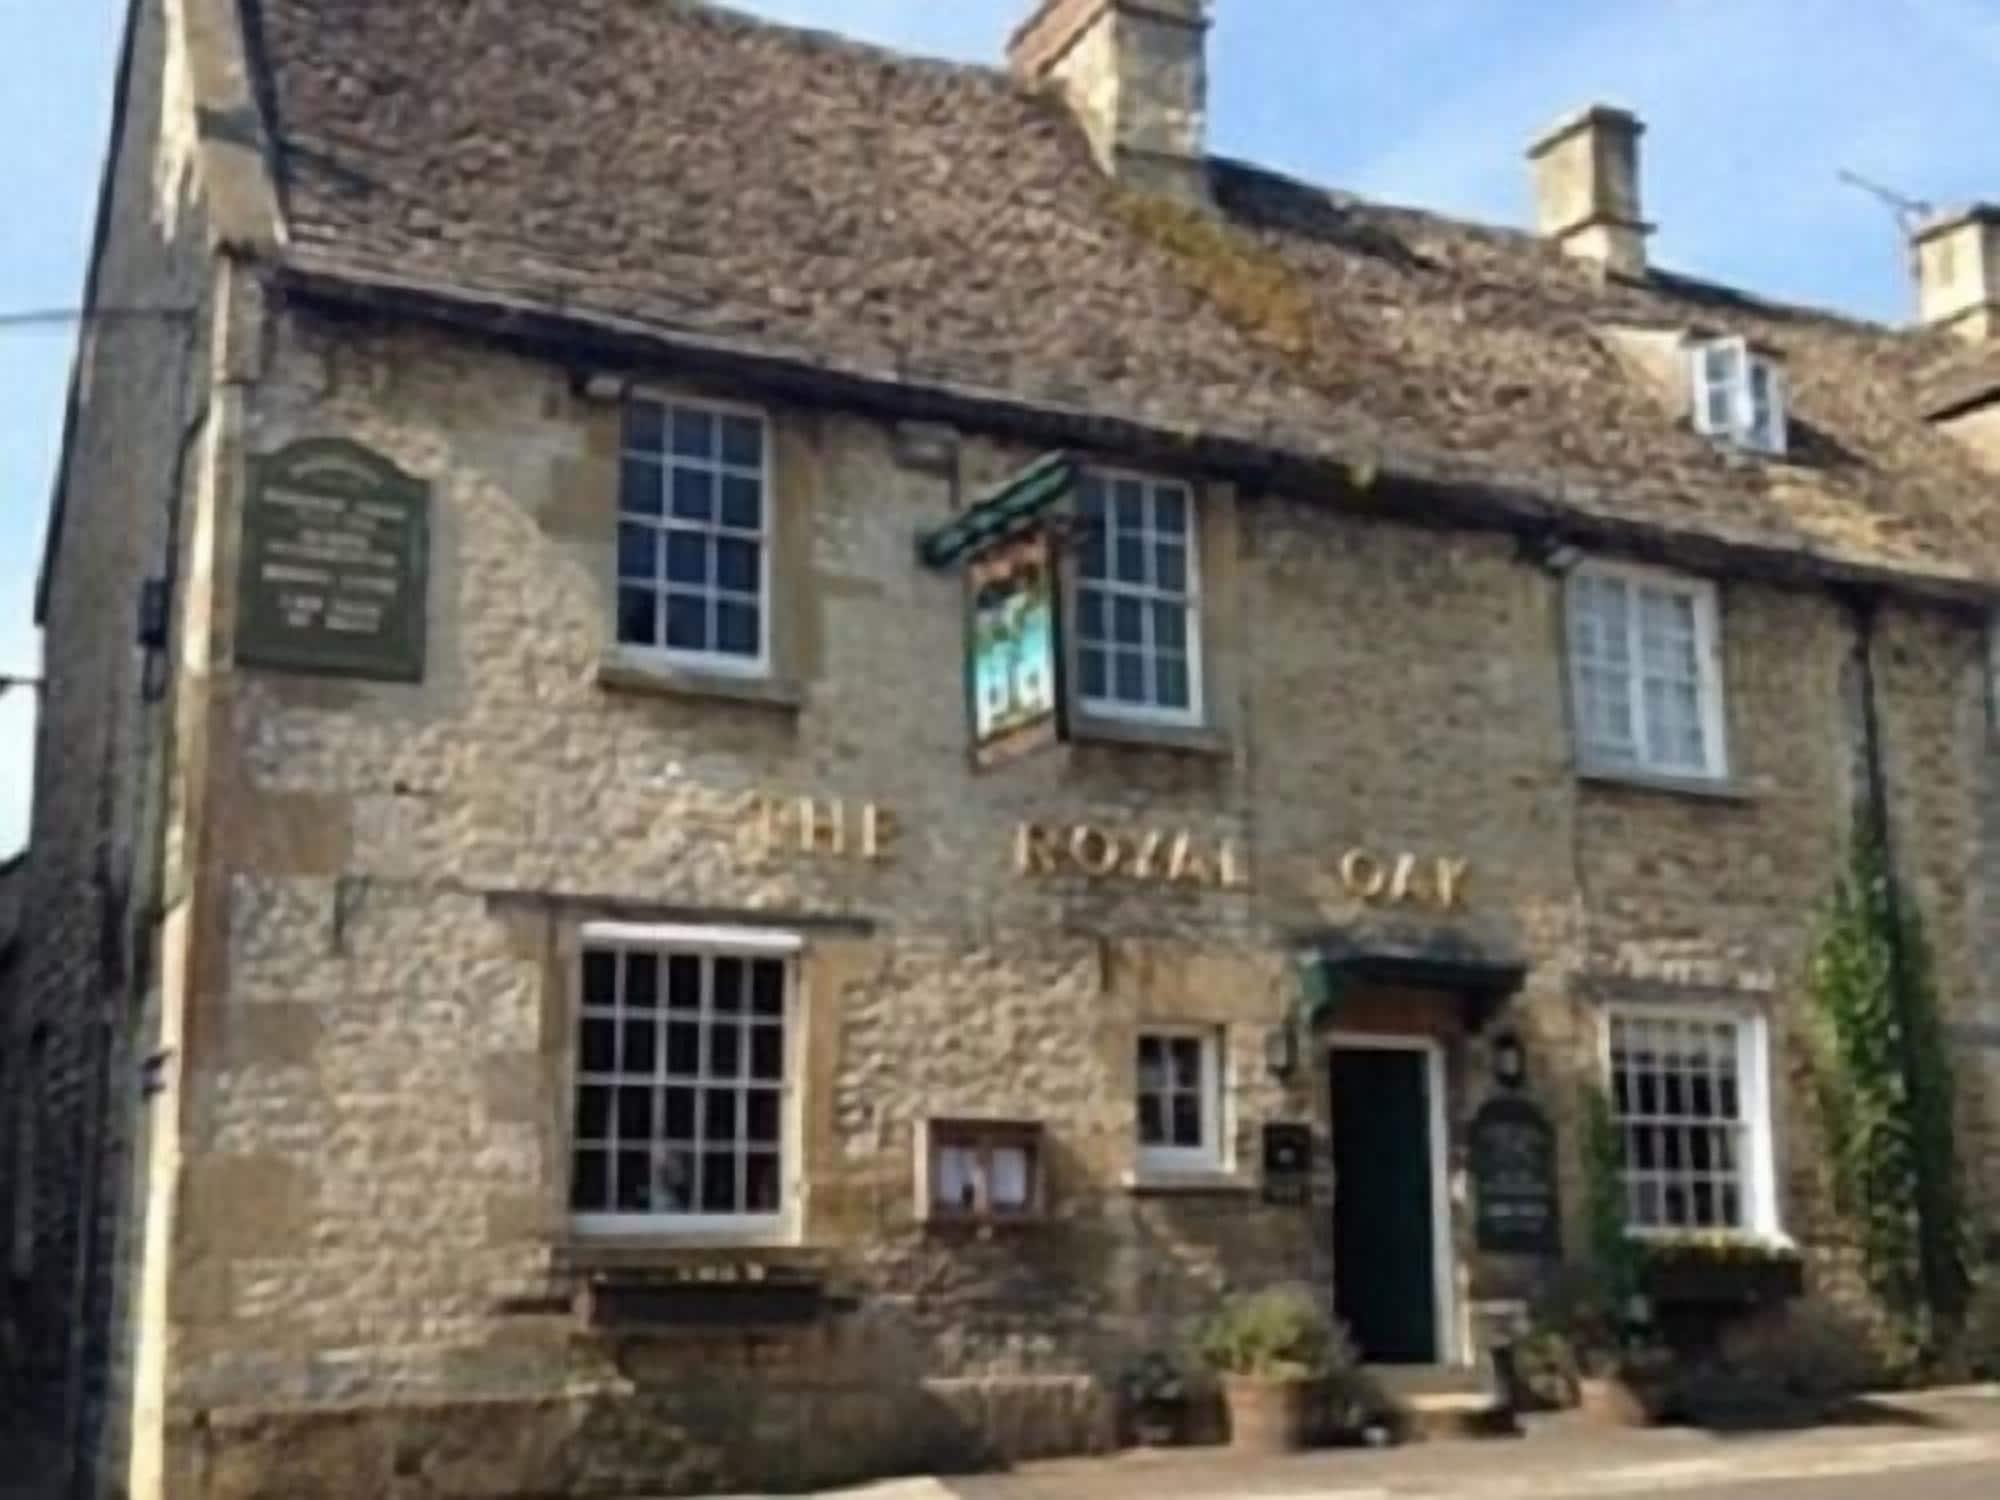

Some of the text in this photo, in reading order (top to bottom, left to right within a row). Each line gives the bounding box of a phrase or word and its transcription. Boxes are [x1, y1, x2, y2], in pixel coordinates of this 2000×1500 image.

[752, 797, 1470, 908] THE ROYAL OAK
